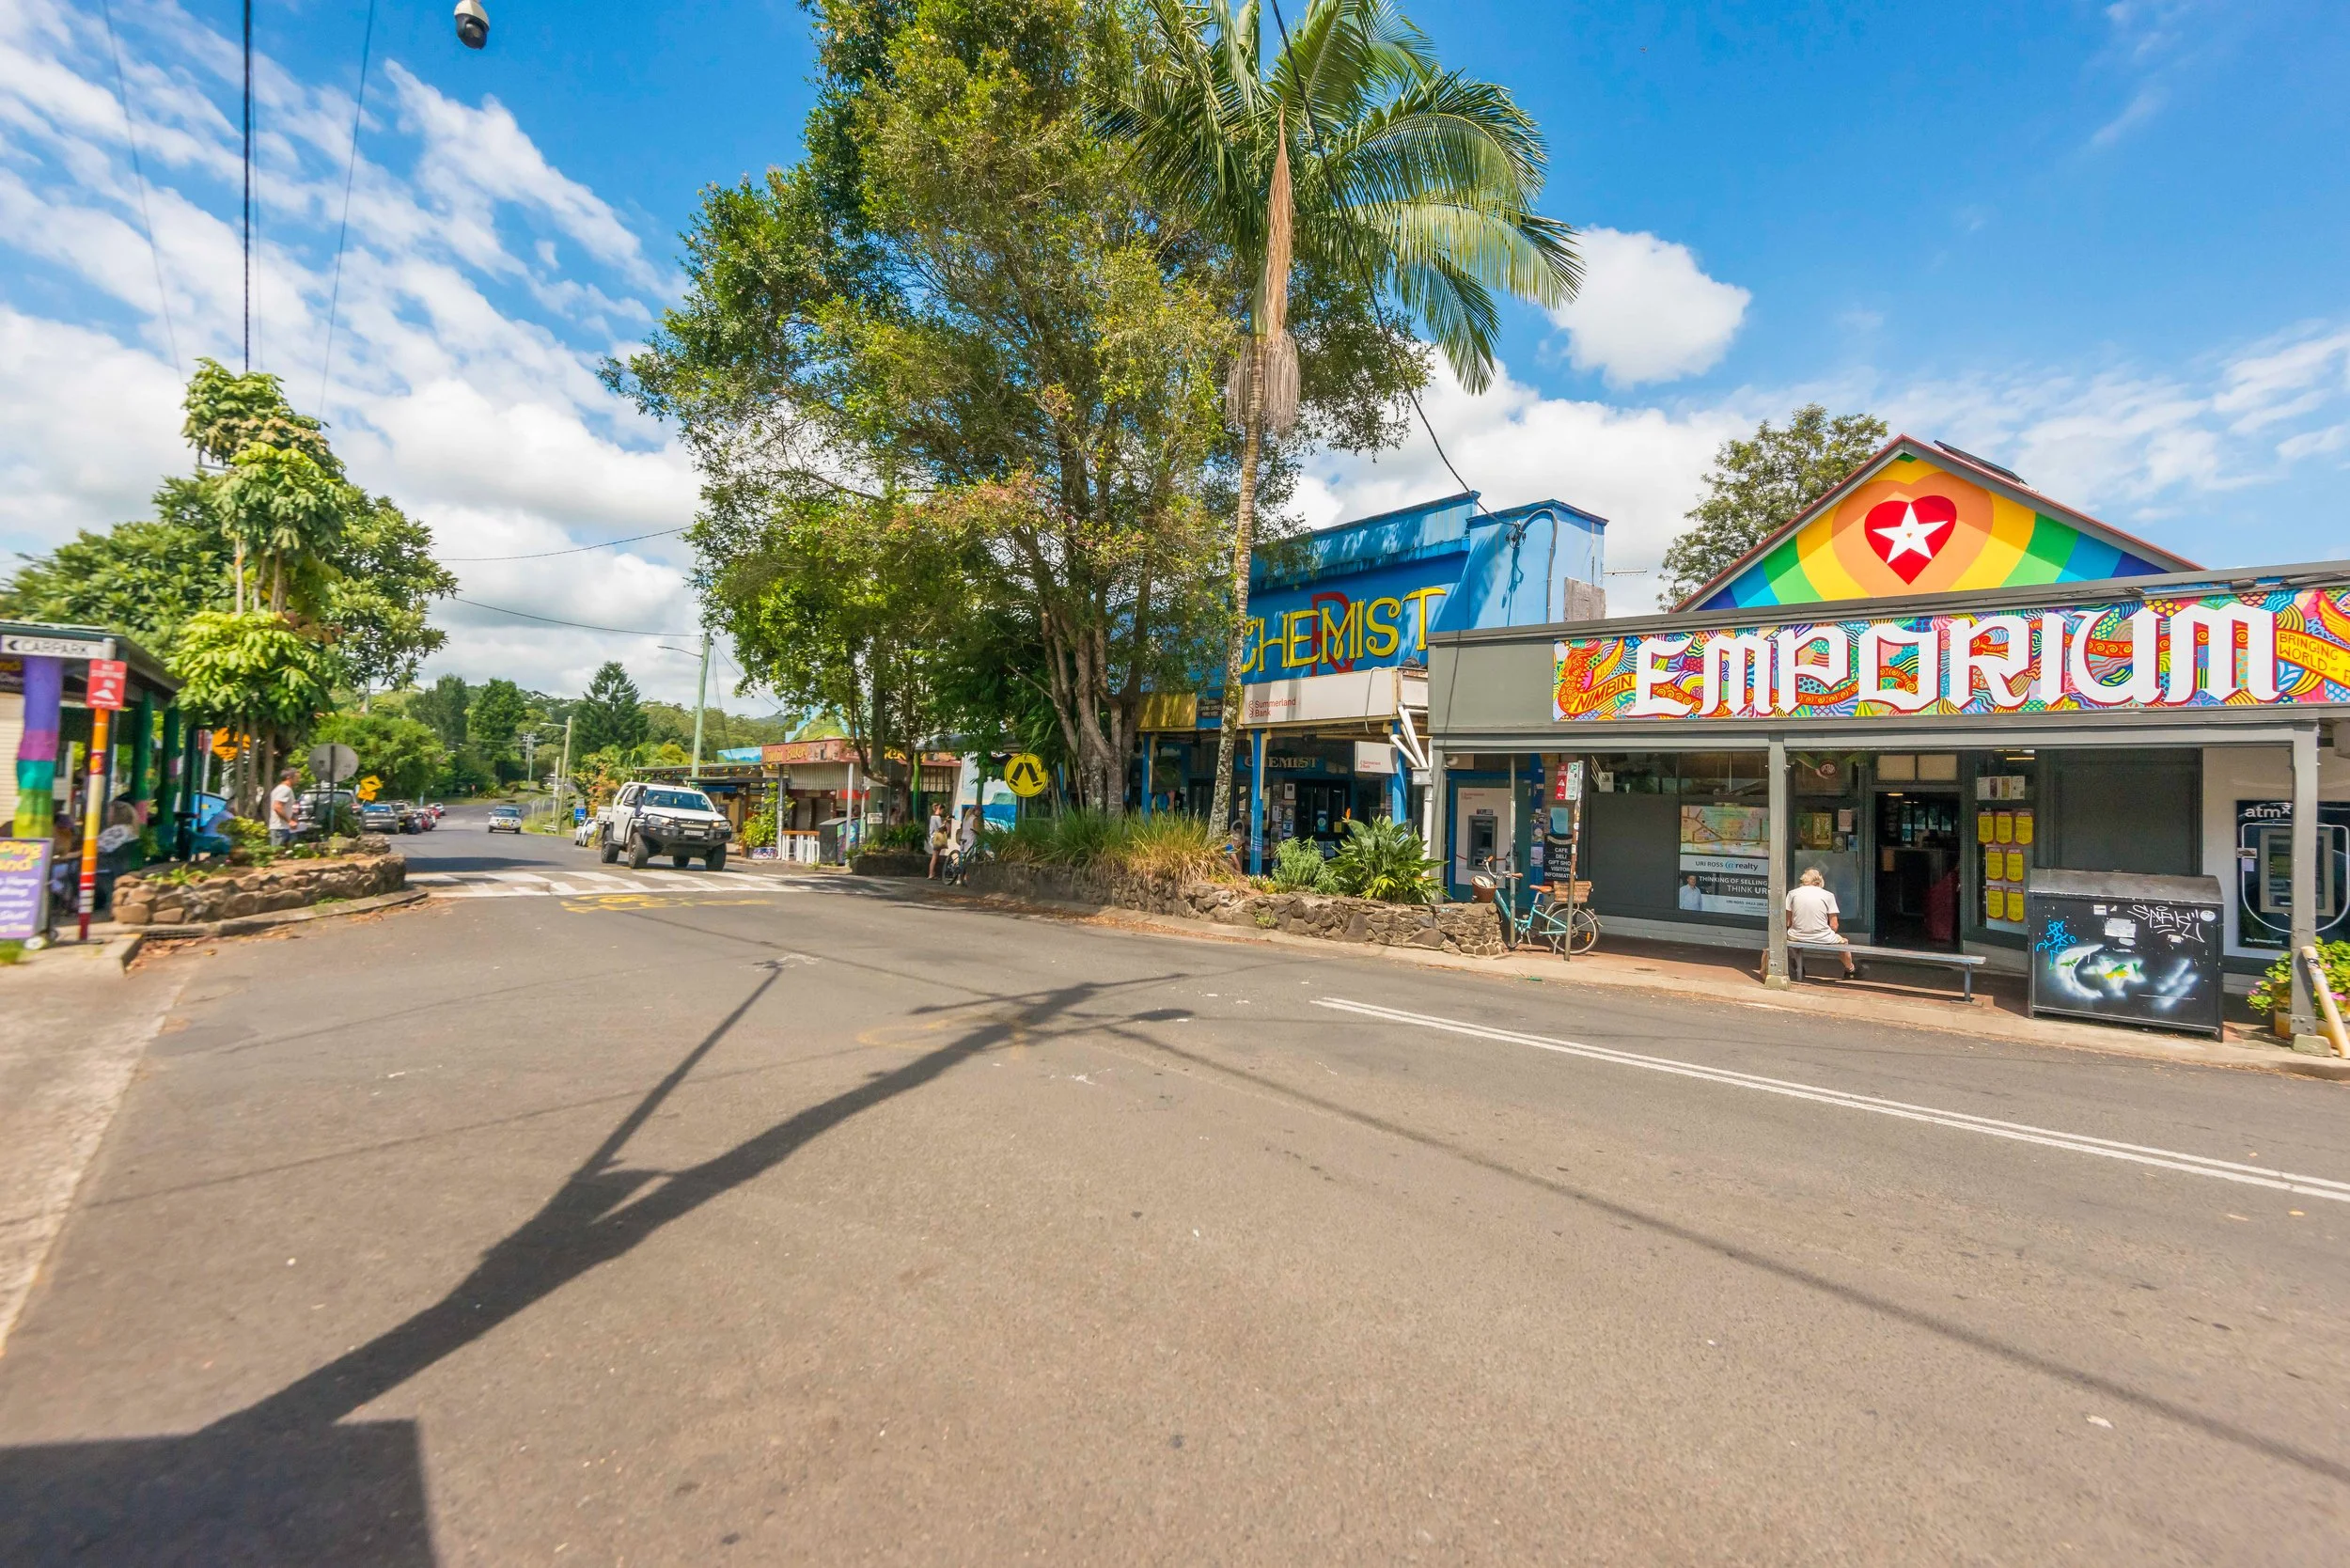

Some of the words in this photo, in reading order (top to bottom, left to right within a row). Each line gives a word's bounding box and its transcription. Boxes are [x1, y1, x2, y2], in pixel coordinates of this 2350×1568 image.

[1242, 588, 1446, 673] CHEMIST
[2280, 633, 2339, 661] BRINGING
[1626, 603, 2282, 718] EMPORIUM
[2279, 644, 2327, 671] WORLD
[1255, 698, 1296, 709] Summerland
[1574, 675, 1633, 712] NIMBIN
[1255, 709, 1271, 717] Bank
[1244, 756, 1321, 769] CEMIST
[1699, 875, 1730, 884] THINKING
[1727, 885, 1753, 893] THINK
[1754, 886, 1768, 895] UR
